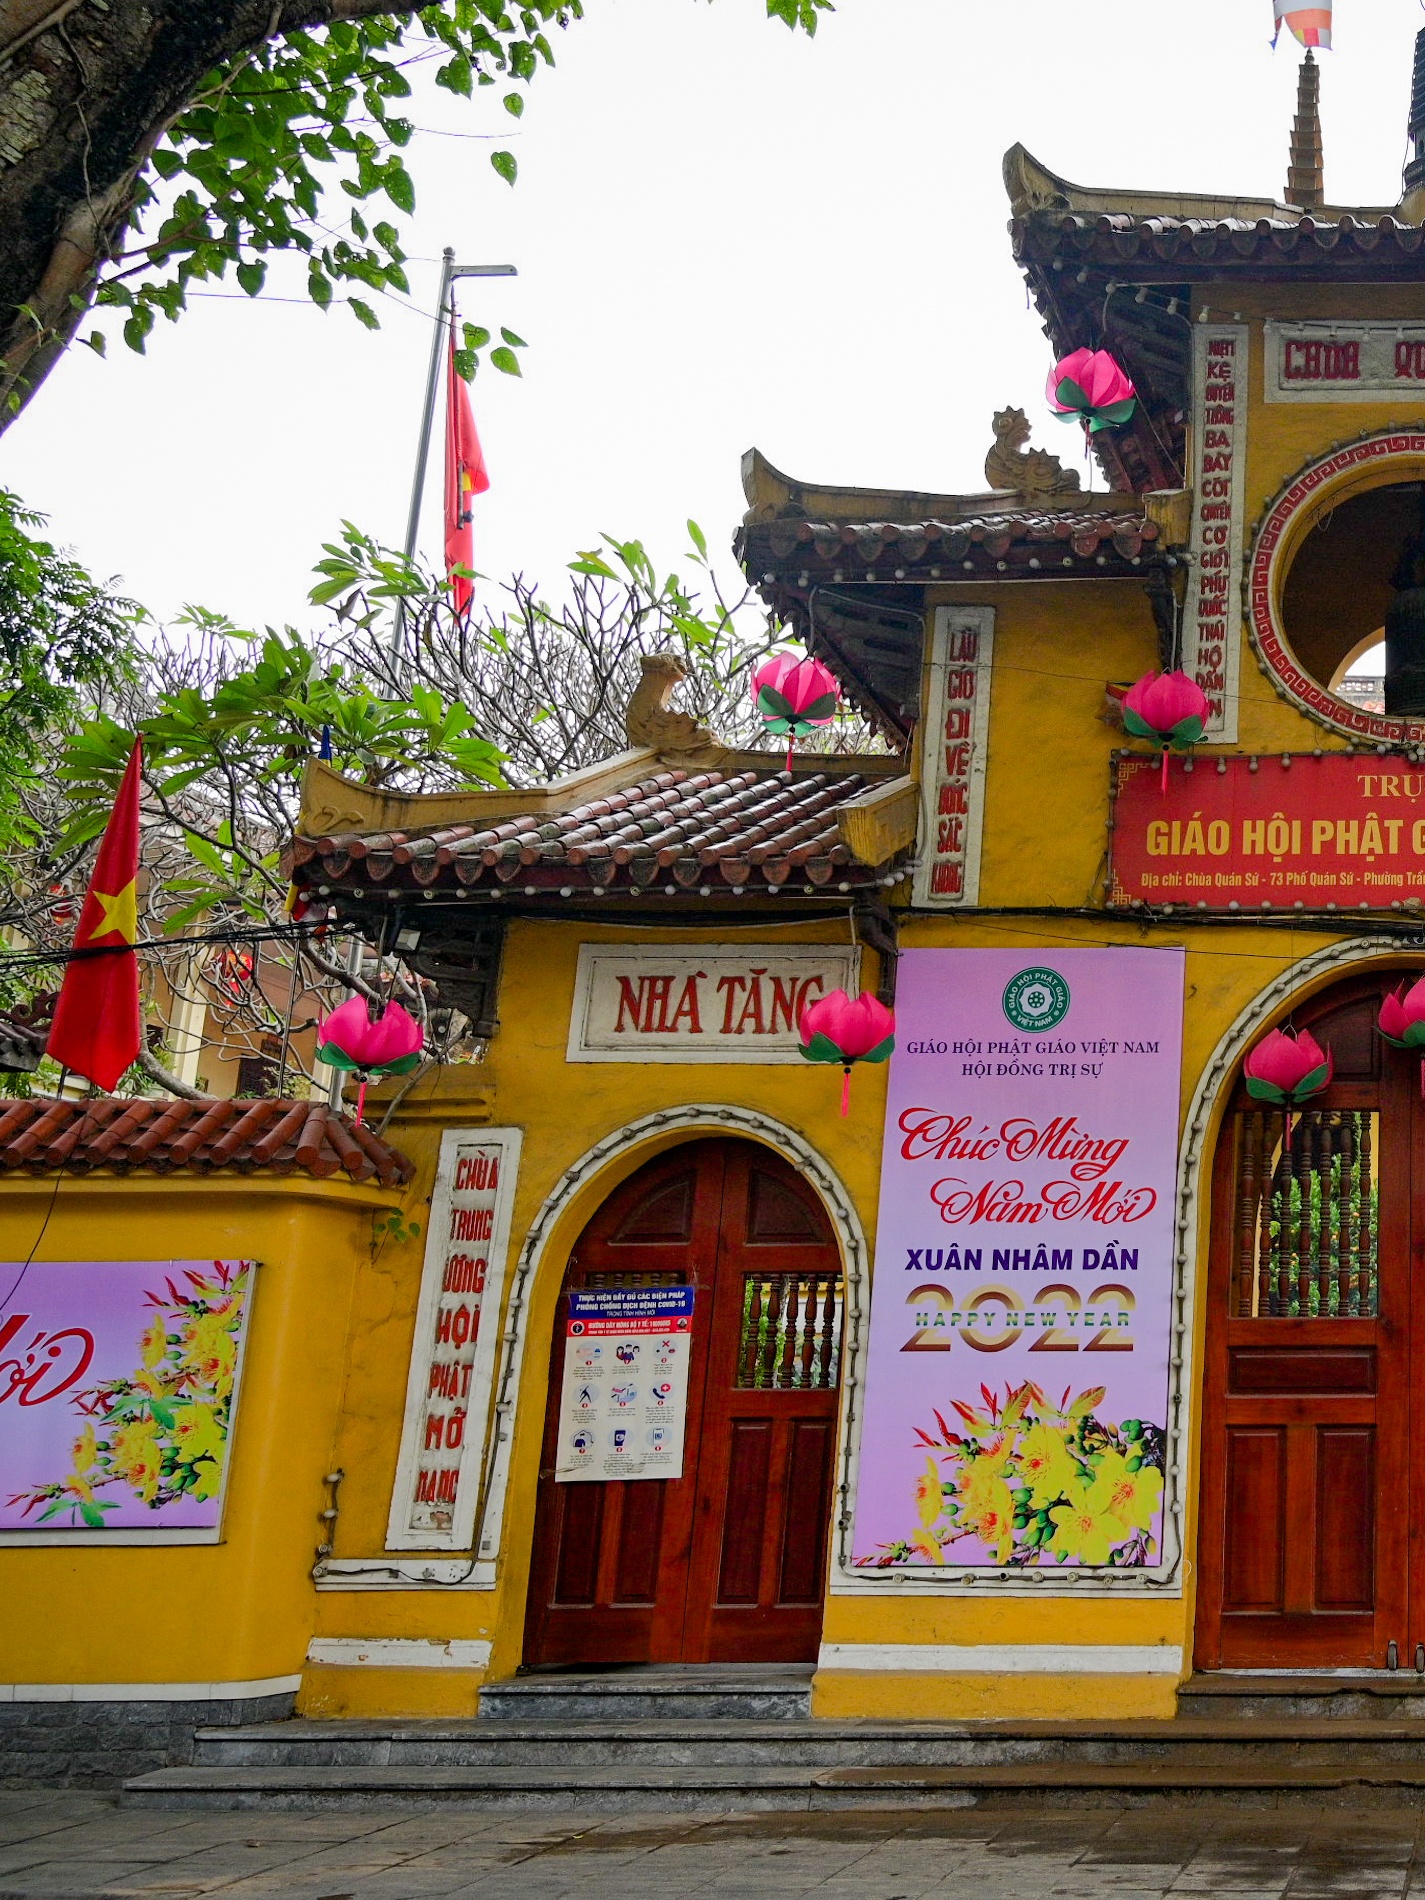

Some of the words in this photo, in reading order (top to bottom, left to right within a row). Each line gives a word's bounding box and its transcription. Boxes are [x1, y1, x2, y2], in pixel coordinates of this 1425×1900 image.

[1204, 430, 1231, 449] BA
[1358, 775, 1424, 803] TRỤ
[1146, 811, 1231, 855] GIÁO
[1242, 811, 1302, 863] HỘI
[1311, 811, 1400, 863] PHẬT
[1141, 873, 1159, 888] Địa
[1185, 872, 1211, 886] Chùa
[1215, 872, 1242, 887] Quán
[1244, 871, 1258, 886] Sứ
[1270, 872, 1283, 886] 73
[1286, 870, 1306, 886] Phố
[1309, 871, 1336, 887] Quán
[1339, 871, 1353, 886] Sứ
[1363, 871, 1404, 887] Phường
[614, 971, 708, 1033] NHÀ
[1034, 1015, 1054, 1027] NAM
[907, 1039, 948, 1054] GIÁO
[952, 1038, 982, 1056] HỘI
[987, 1038, 1031, 1056] PHẬT
[1035, 1039, 1076, 1054] GIÁO
[1081, 1038, 1119, 1056] VIỆT
[1123, 1041, 1160, 1054] NAM
[961, 1060, 993, 1077] HỘI
[996, 1058, 1044, 1076] ĐỒNG
[1049, 1063, 1077, 1078] TRỊ
[1081, 1063, 1104, 1078] SỰ
[898, 1107, 1000, 1161] Chúc
[1000, 1116, 1130, 1181] Mừng
[455, 1150, 498, 1191] CHÙA
[1041, 1180, 1157, 1224] Mới
[450, 1208, 494, 1241] TRUNG
[905, 1243, 982, 1270] XUÂN
[992, 1243, 1072, 1270] NHÂM
[1083, 1240, 1138, 1270] DẦN
[668, 1291, 685, 1299] PHÁP
[435, 1303, 478, 1349] HỘI
[900, 1283, 1136, 1352] 2022
[915, 1312, 995, 1327] HAPPY
[1006, 1312, 1058, 1327] NEW
[1068, 1312, 1131, 1327] YEAR
[0, 1314, 98, 1410] ới
[430, 1361, 474, 1401] PHẬT
[425, 1411, 467, 1450] MỞ
